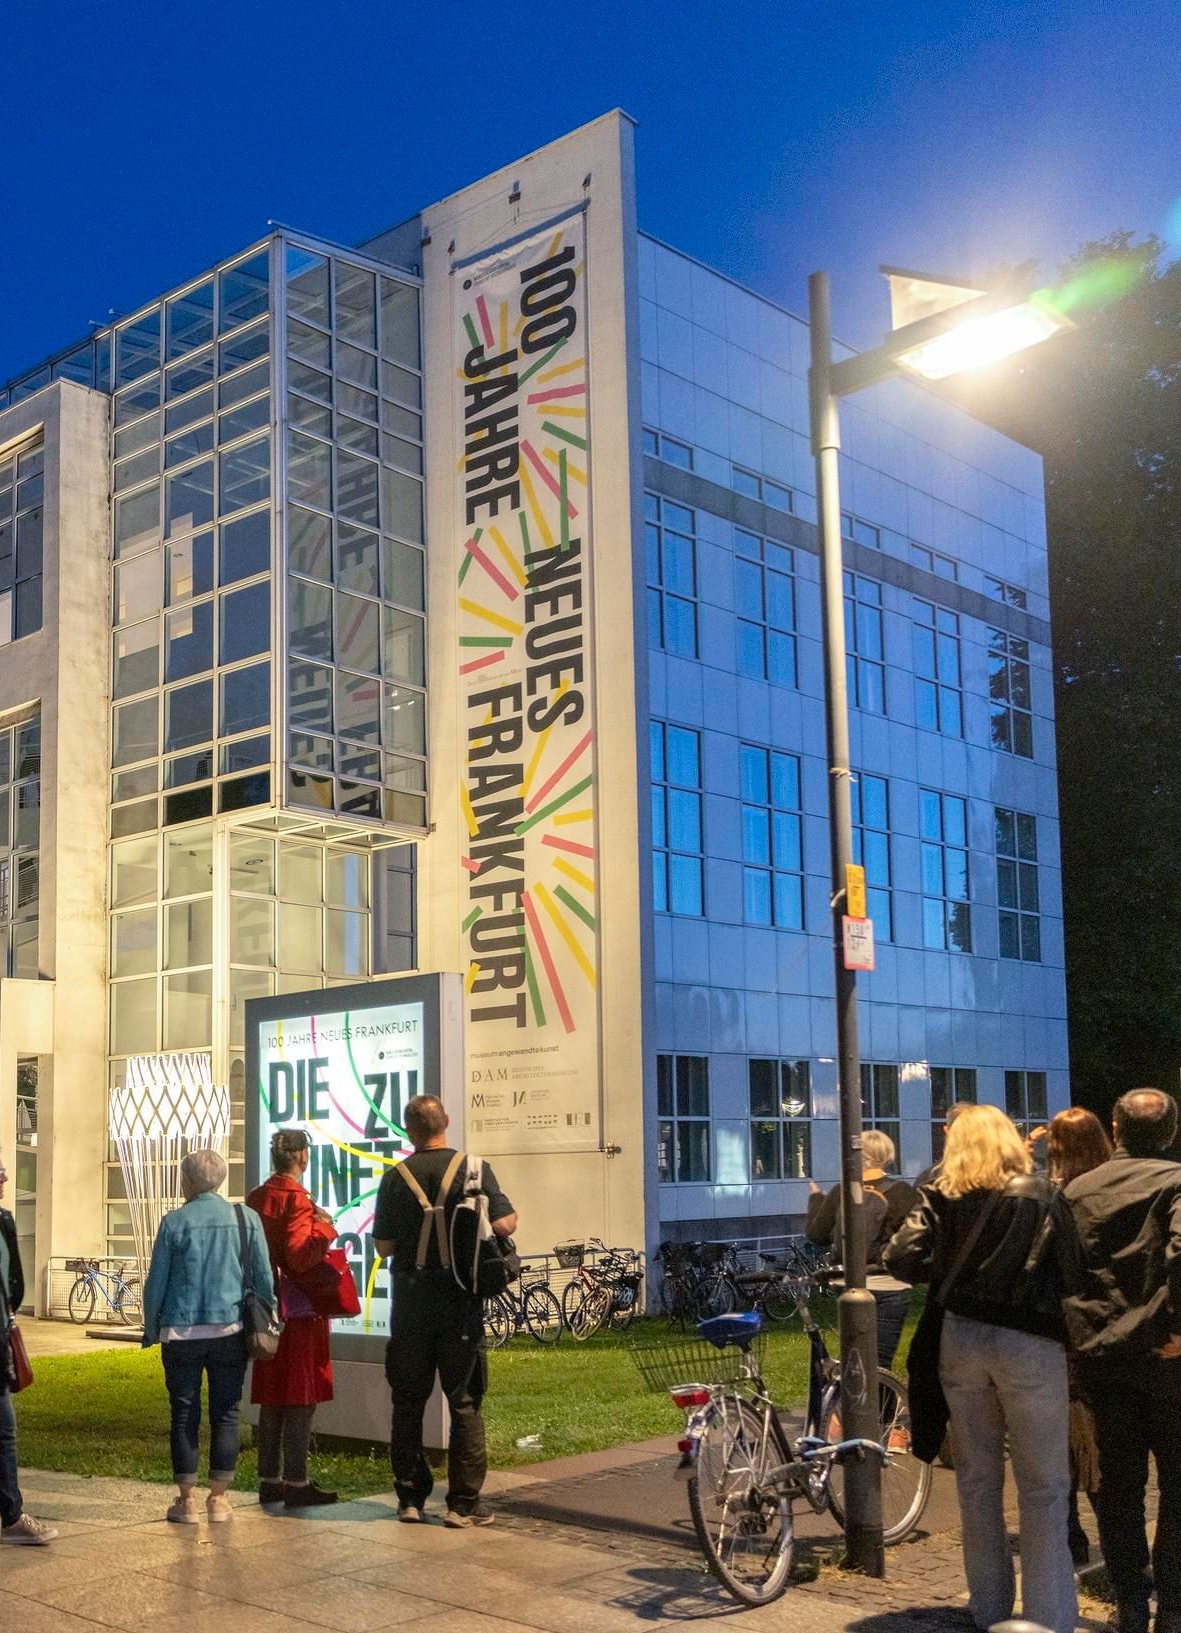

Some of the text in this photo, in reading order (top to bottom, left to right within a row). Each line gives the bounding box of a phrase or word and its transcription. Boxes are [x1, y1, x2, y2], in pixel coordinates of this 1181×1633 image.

[520, 246, 576, 355] 100
[464, 344, 520, 526] JAHRE
[524, 537, 584, 733] NEUES
[468, 682, 526, 1029] FRANKFURT
[267, 1019, 418, 1049] 100 JAHRE NEUES FRANKFURT
[269, 1056, 329, 1124] DIE
